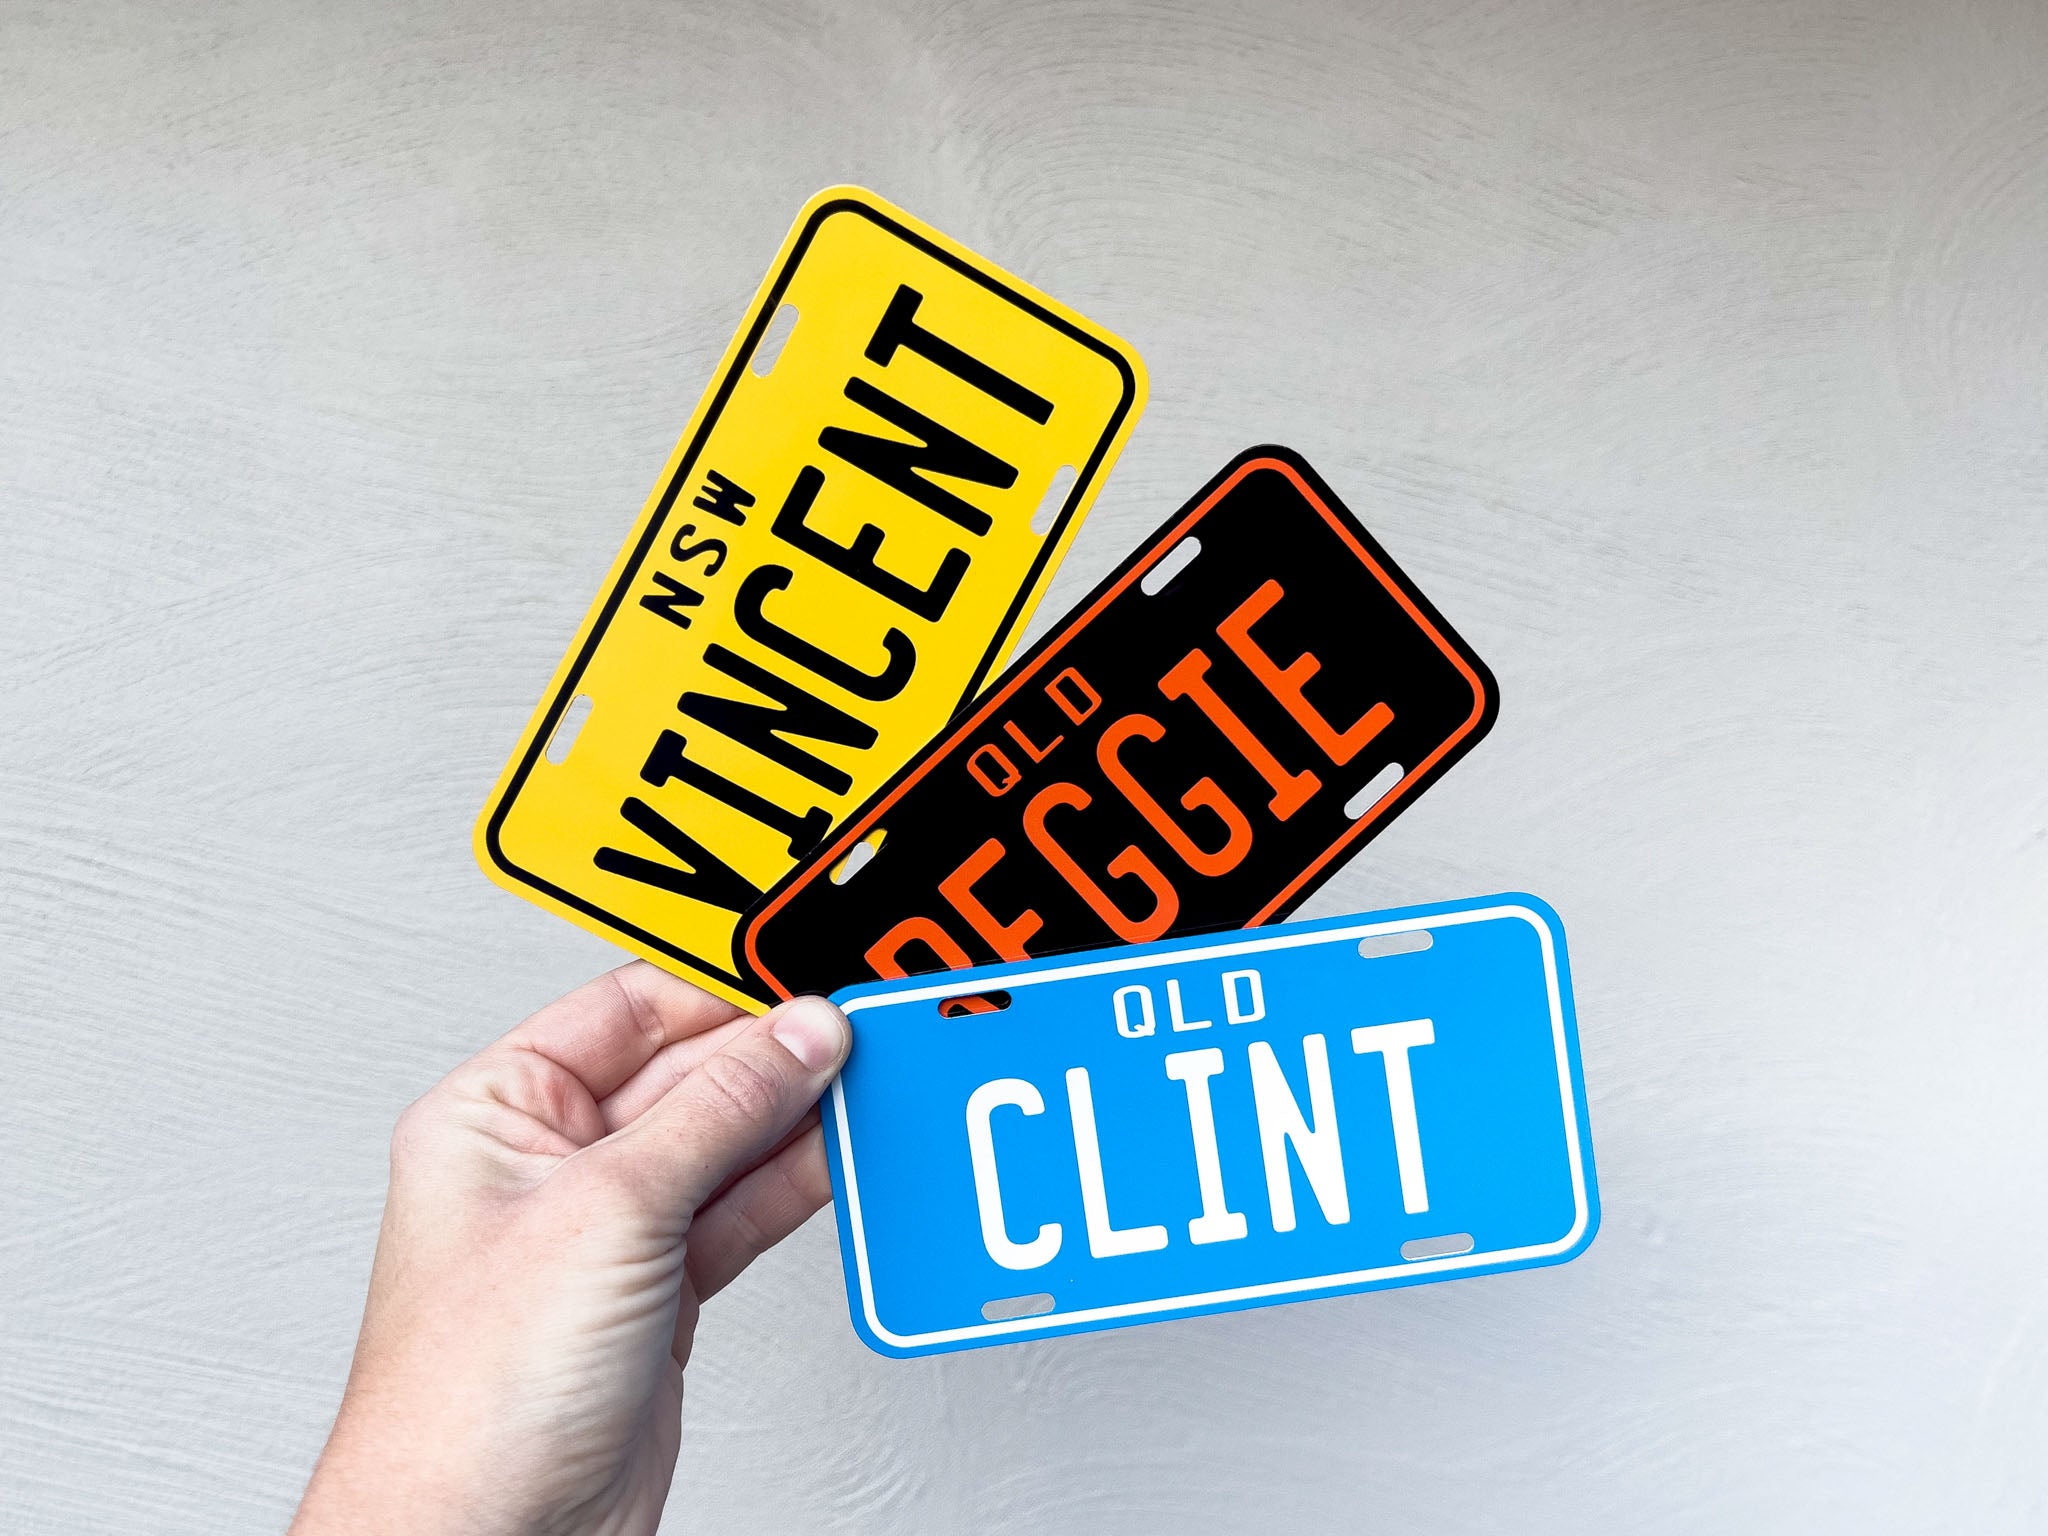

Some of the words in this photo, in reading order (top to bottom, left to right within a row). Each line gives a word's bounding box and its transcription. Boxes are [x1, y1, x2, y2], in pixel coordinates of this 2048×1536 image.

[594, 284, 1054, 913] VINCENT
[639, 470, 756, 630] NSW
[966, 667, 1103, 797] QLD
[1113, 970, 1265, 1038] QLD
[966, 1019, 1435, 1270] CLINT
